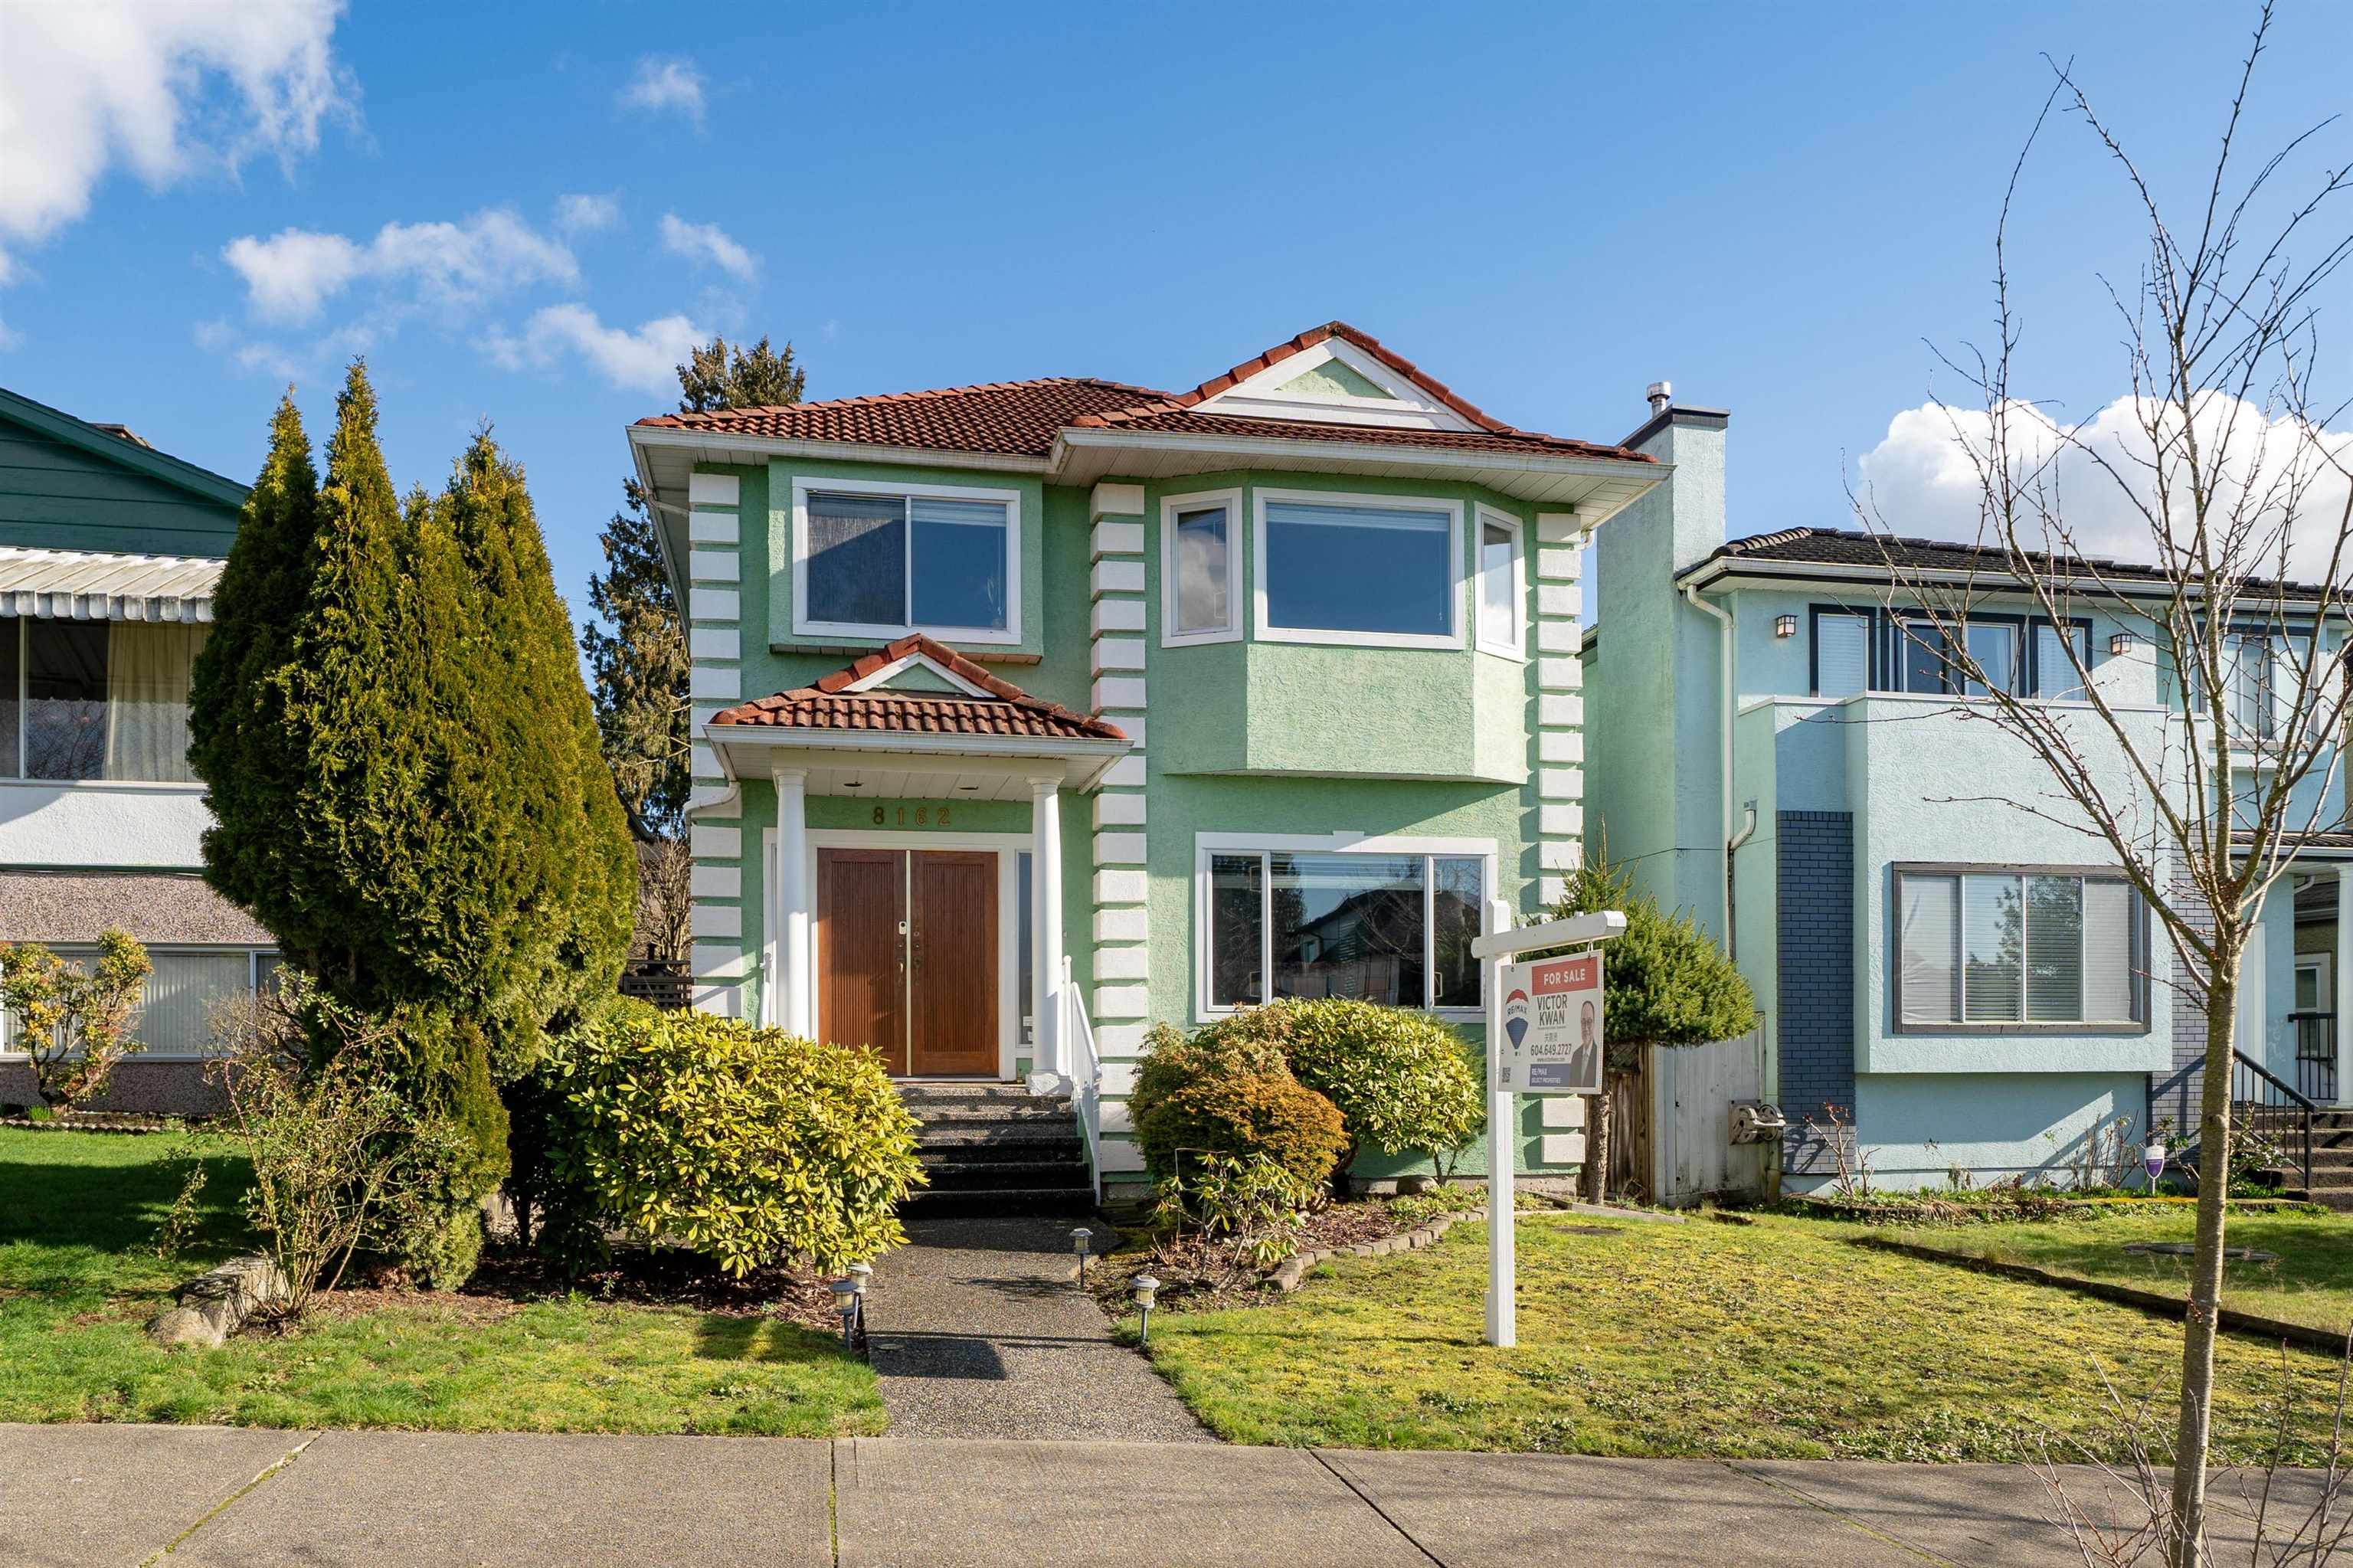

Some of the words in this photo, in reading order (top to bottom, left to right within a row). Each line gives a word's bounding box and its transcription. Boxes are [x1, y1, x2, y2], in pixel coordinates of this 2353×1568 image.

[872, 807, 951, 827] 8162
[1543, 972, 1561, 986] FOR
[1563, 968, 1586, 983] SALE
[1507, 1004, 1527, 1016] RE/MAX
[1536, 994, 1567, 1010] VICTOR
[1539, 1010, 1565, 1026] KWAN
[1530, 1043, 1572, 1056] 604.649.2727
